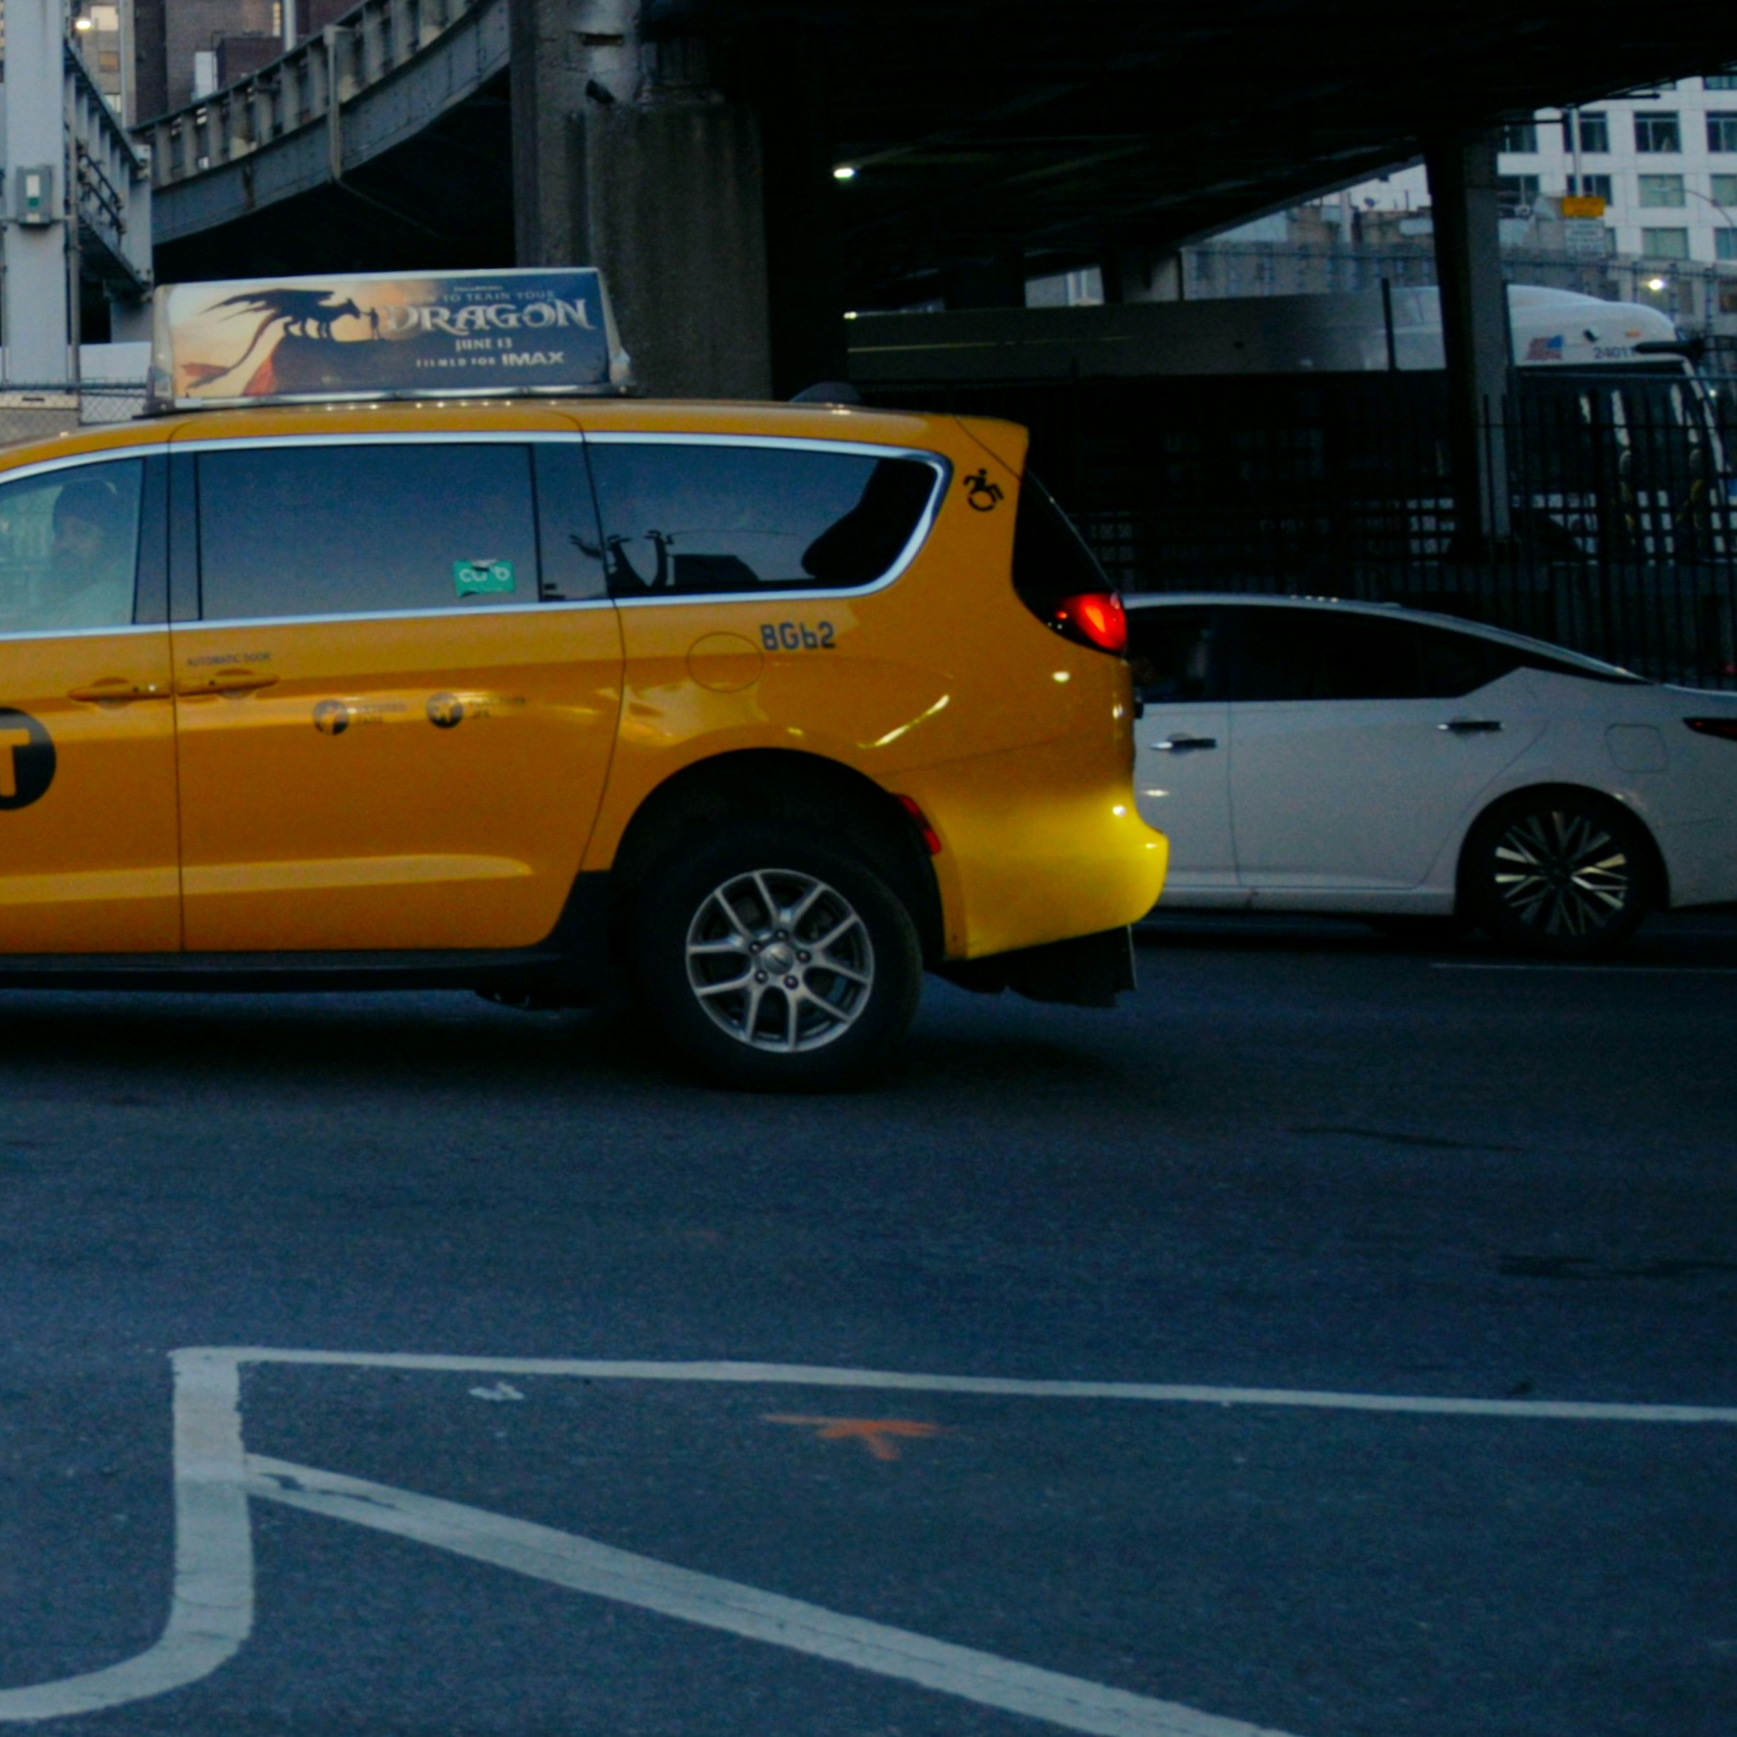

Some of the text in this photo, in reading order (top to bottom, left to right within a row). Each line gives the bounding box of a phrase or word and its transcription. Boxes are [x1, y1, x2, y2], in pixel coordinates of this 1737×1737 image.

[442, 293, 462, 304] TO
[467, 291, 511, 303] TRAIN
[517, 289, 556, 301] YOUR
[386, 297, 598, 337] DRAGON
[455, 337, 513, 353] JUNE 13
[416, 350, 565, 369] FILMED FOR IMAX
[459, 565, 510, 583] cub
